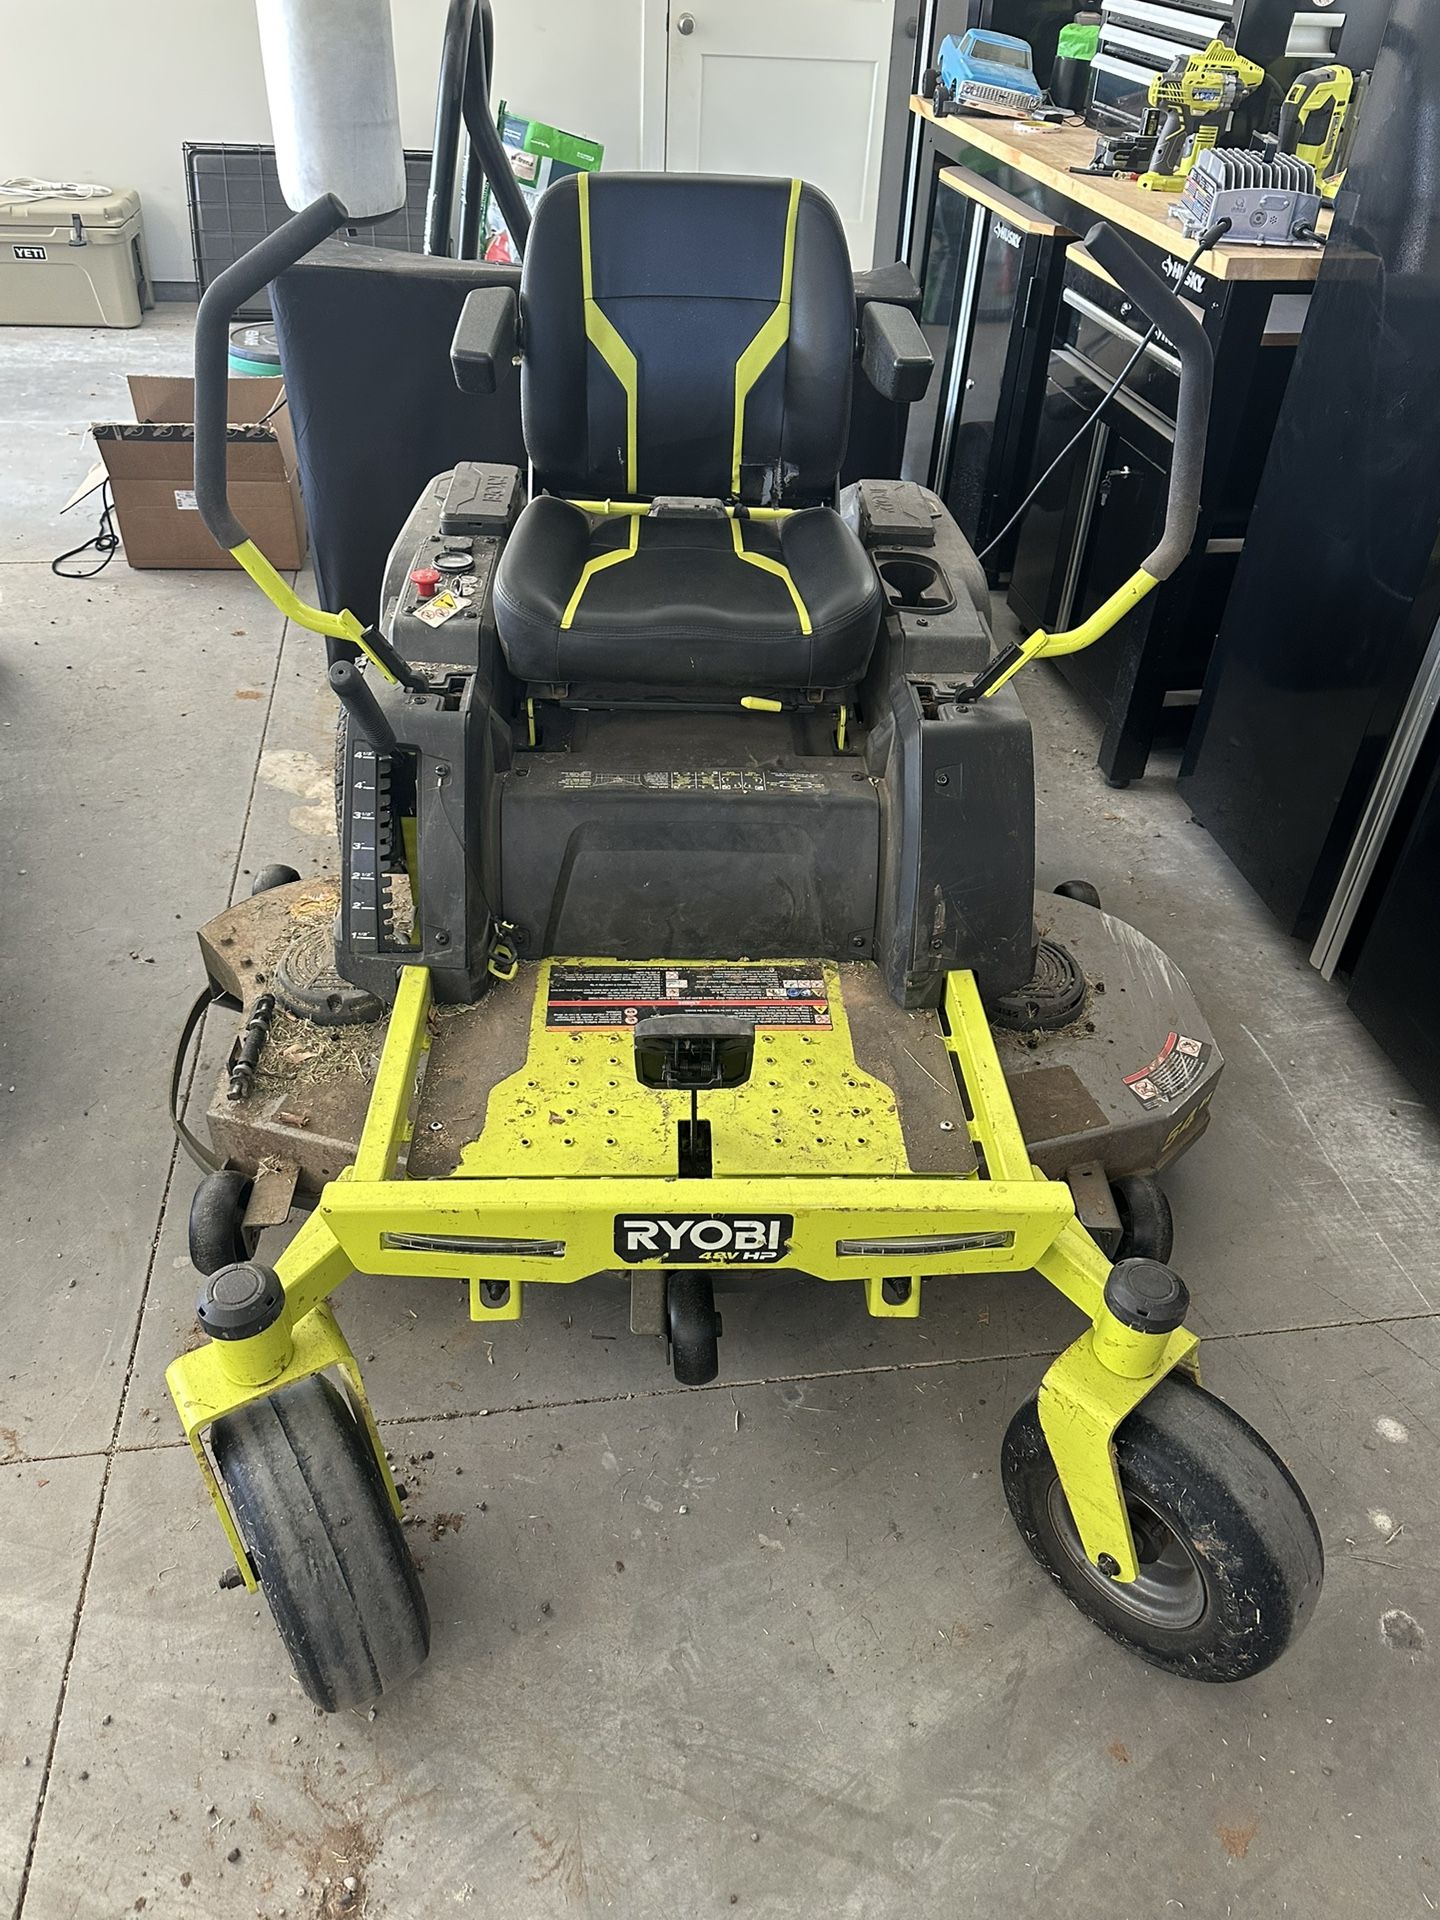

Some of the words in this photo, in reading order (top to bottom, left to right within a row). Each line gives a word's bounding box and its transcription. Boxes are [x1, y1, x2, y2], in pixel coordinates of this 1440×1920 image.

[1000, 225, 1022, 248] HUSKY
[14, 247, 44, 258] YETI
[623, 1219, 782, 1251] RYOBI
[743, 1251, 778, 1260] HP
